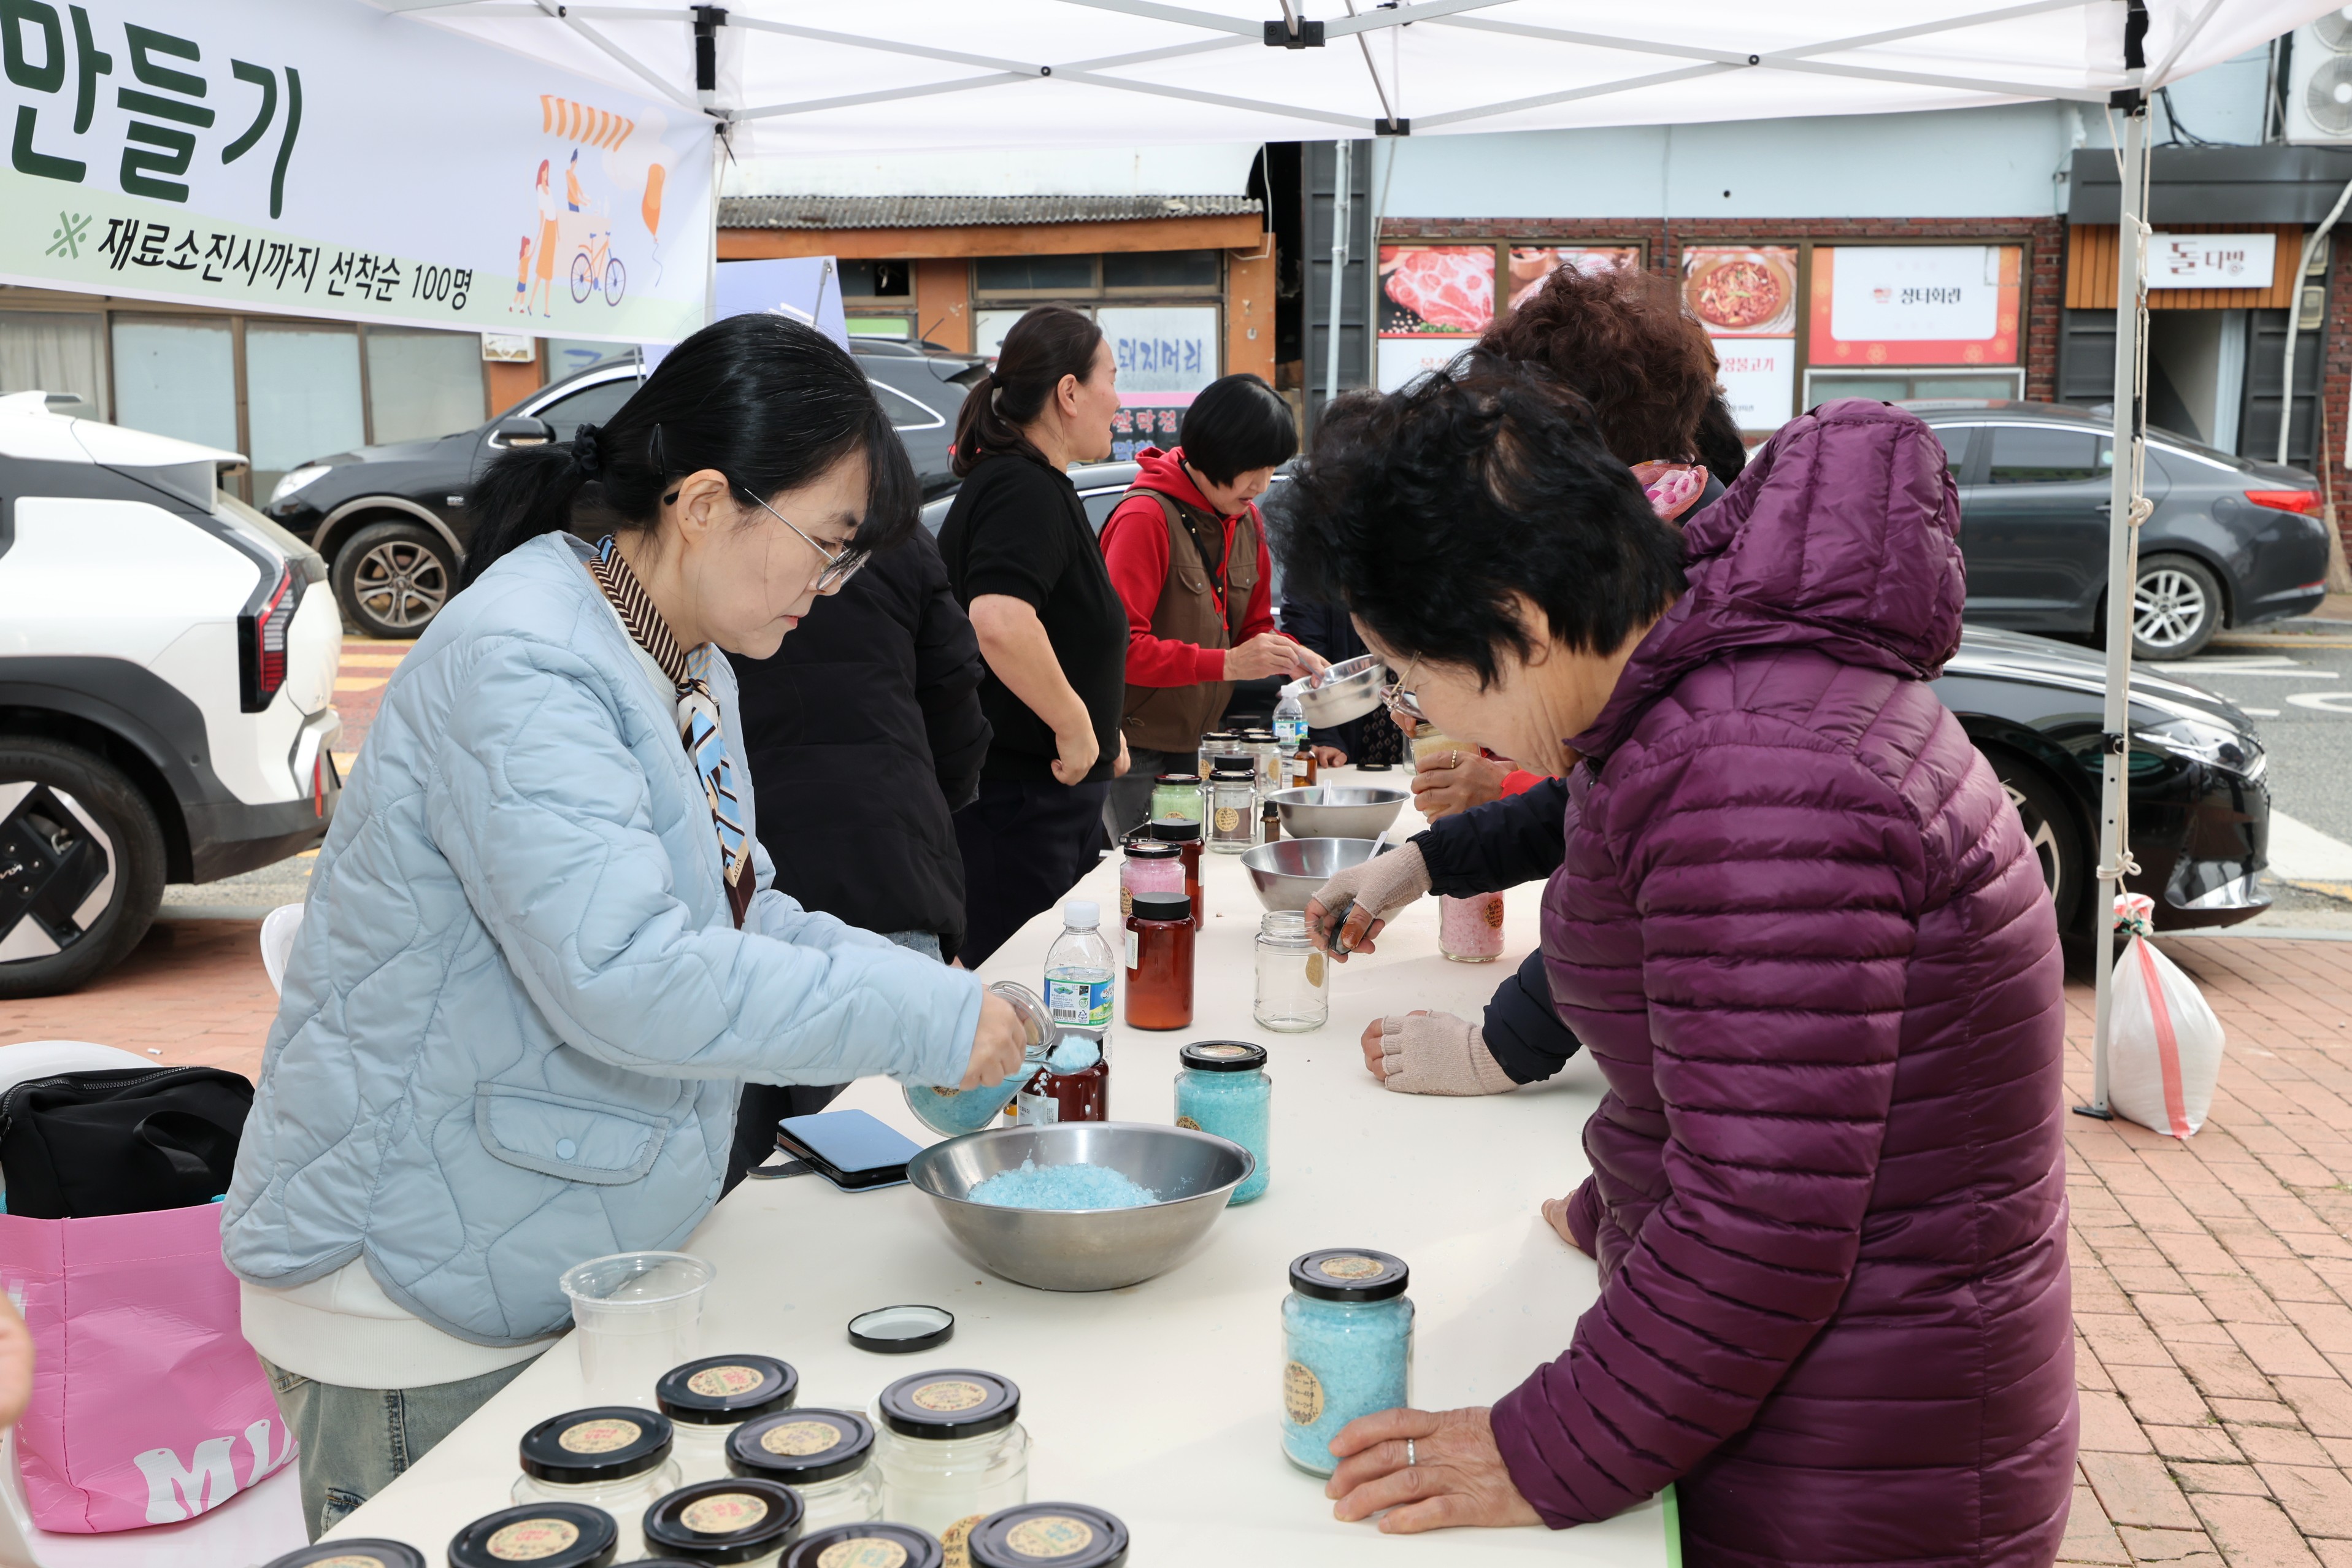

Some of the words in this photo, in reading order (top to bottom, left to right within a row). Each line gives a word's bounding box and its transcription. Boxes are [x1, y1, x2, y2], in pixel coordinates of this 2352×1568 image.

[0, 0, 302, 220] 만들기
[98, 218, 320, 293] 재료소진시까지
[328, 252, 401, 302] 선착순
[412, 264, 473, 310] 100명
[1900, 288, 1961, 305] 장터회관
[1118, 338, 1202, 373] 돼지머리
[1719, 358, 1775, 372] 장불고기
[1112, 409, 1187, 432] 쌀막걸
[734, 858, 742, 880] AZZYS
